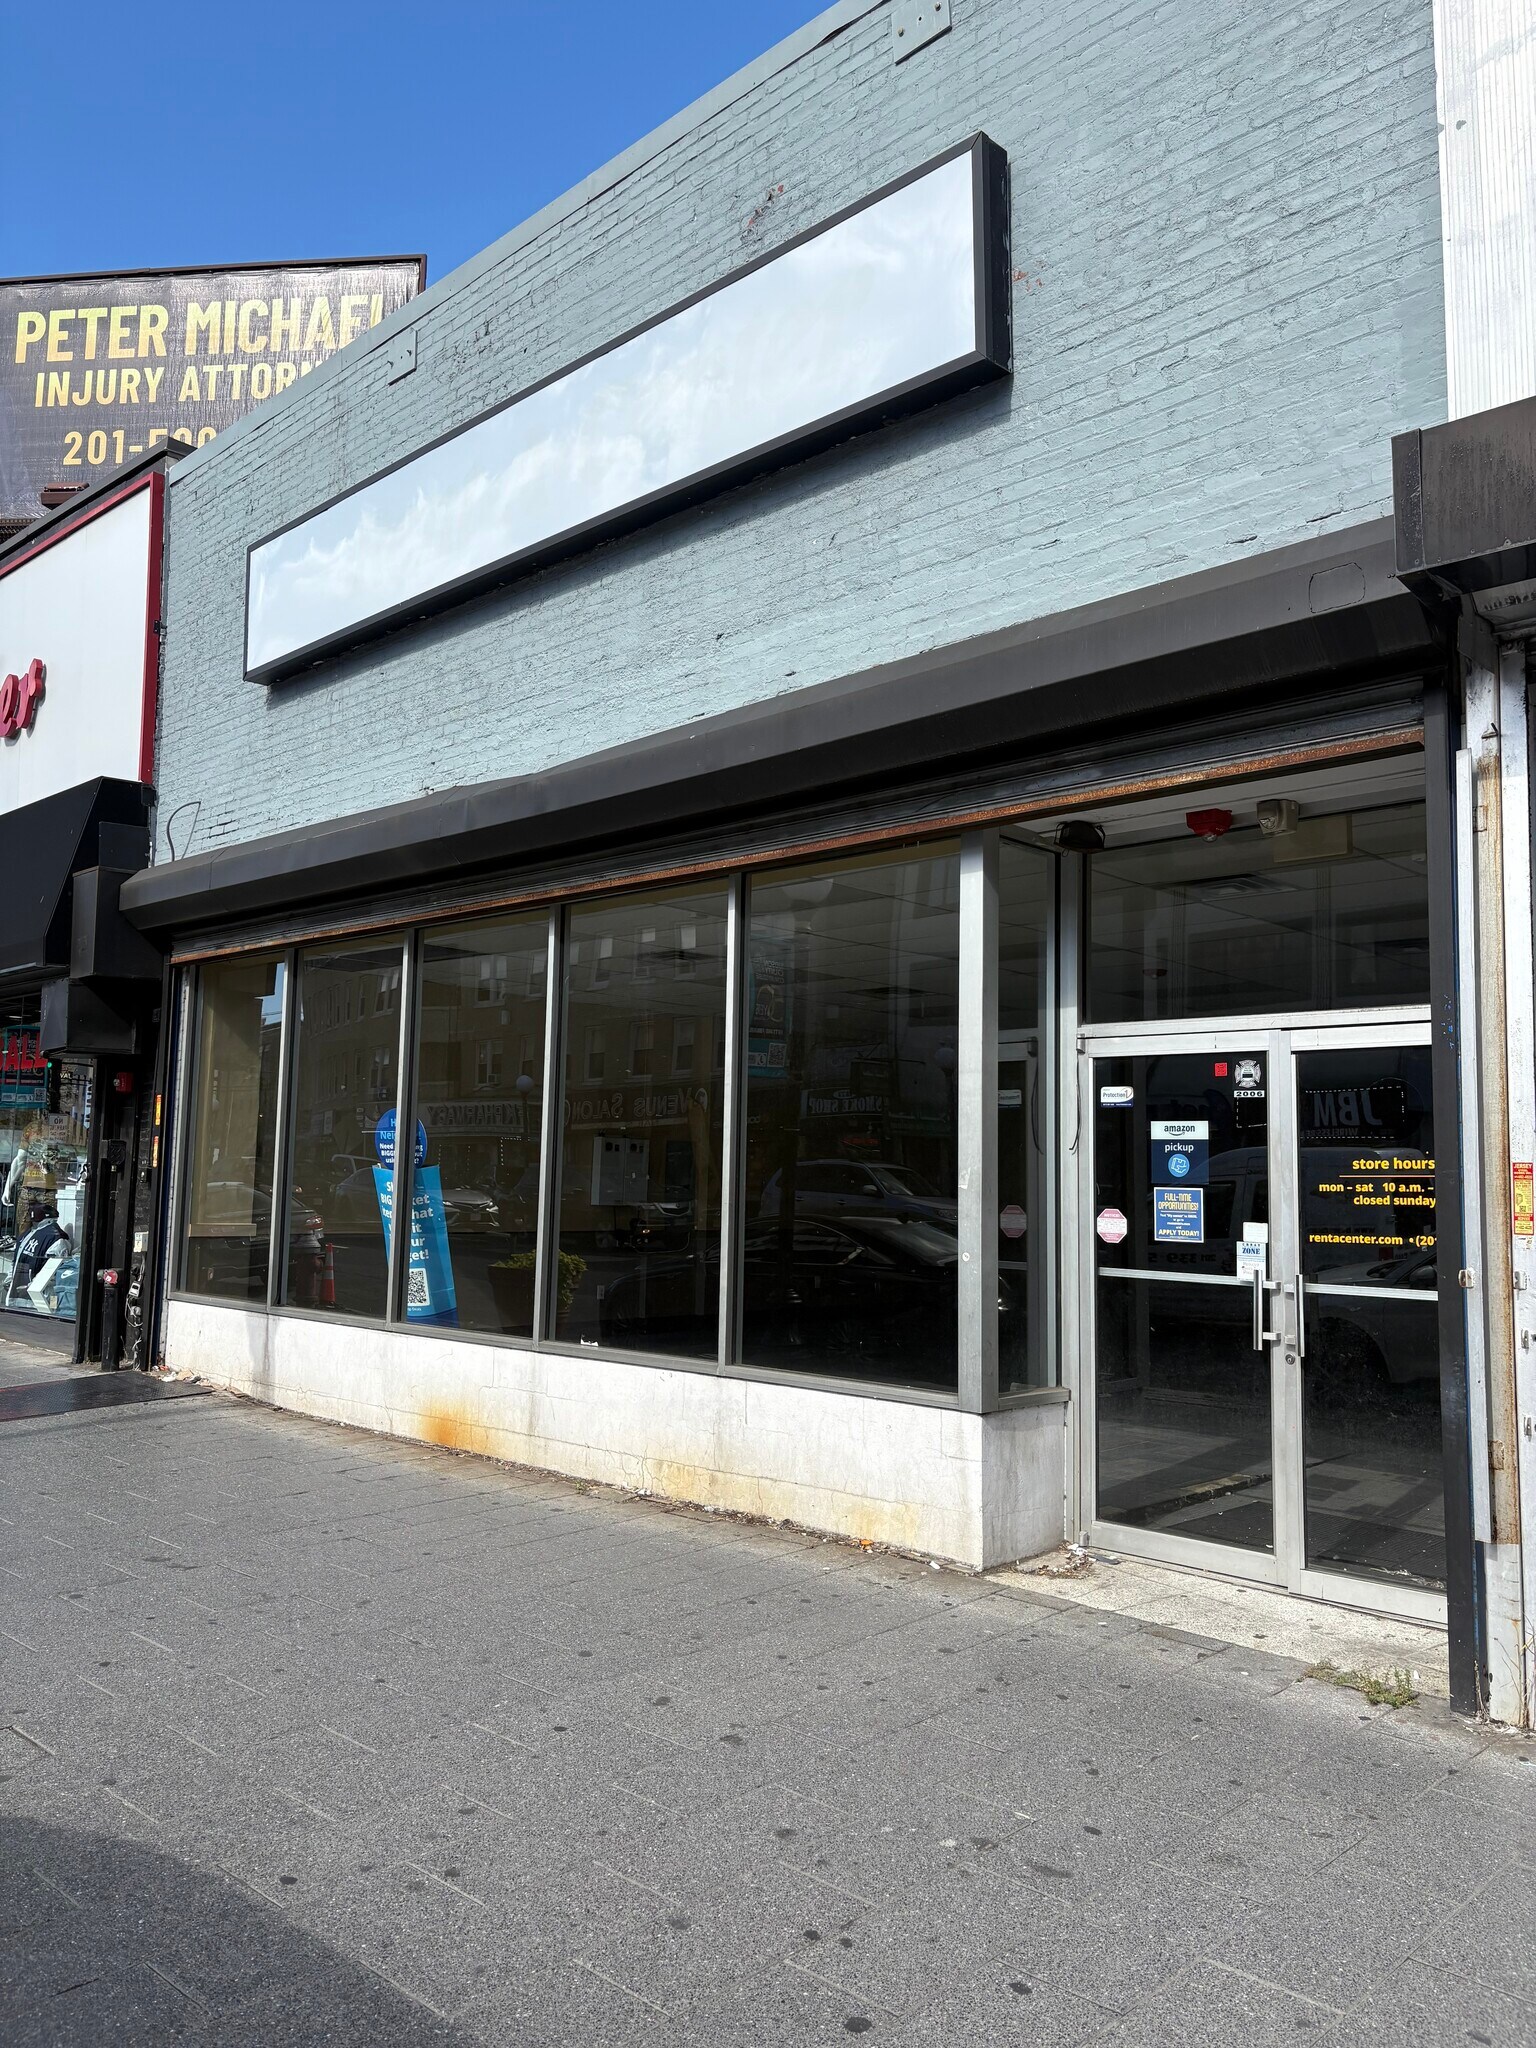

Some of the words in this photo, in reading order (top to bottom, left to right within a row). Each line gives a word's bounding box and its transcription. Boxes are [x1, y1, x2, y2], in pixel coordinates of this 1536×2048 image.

[15, 304, 169, 365] PETER
[35, 367, 165, 408] INJURY
[0, 1032, 48, 1072] ALL
[1164, 1125, 1195, 1134] amazon
[1164, 1143, 1194, 1153] pickup
[1352, 1159, 1389, 1169] store
[1393, 1157, 1435, 1169] hours
[1319, 1184, 1344, 1192] mon
[1355, 1183, 1374, 1192] sat
[1382, 1183, 1395, 1192] 10
[1398, 1184, 1425, 1192] a.m.
[1164, 1193, 1192, 1202] FULL-TIME
[1353, 1195, 1391, 1205] closed
[1393, 1196, 1436, 1208] sunday
[1309, 1233, 1403, 1245] rentacenter.com
[1415, 1235, 1437, 1247] (20
[1242, 1247, 1260, 1255] ZONE
